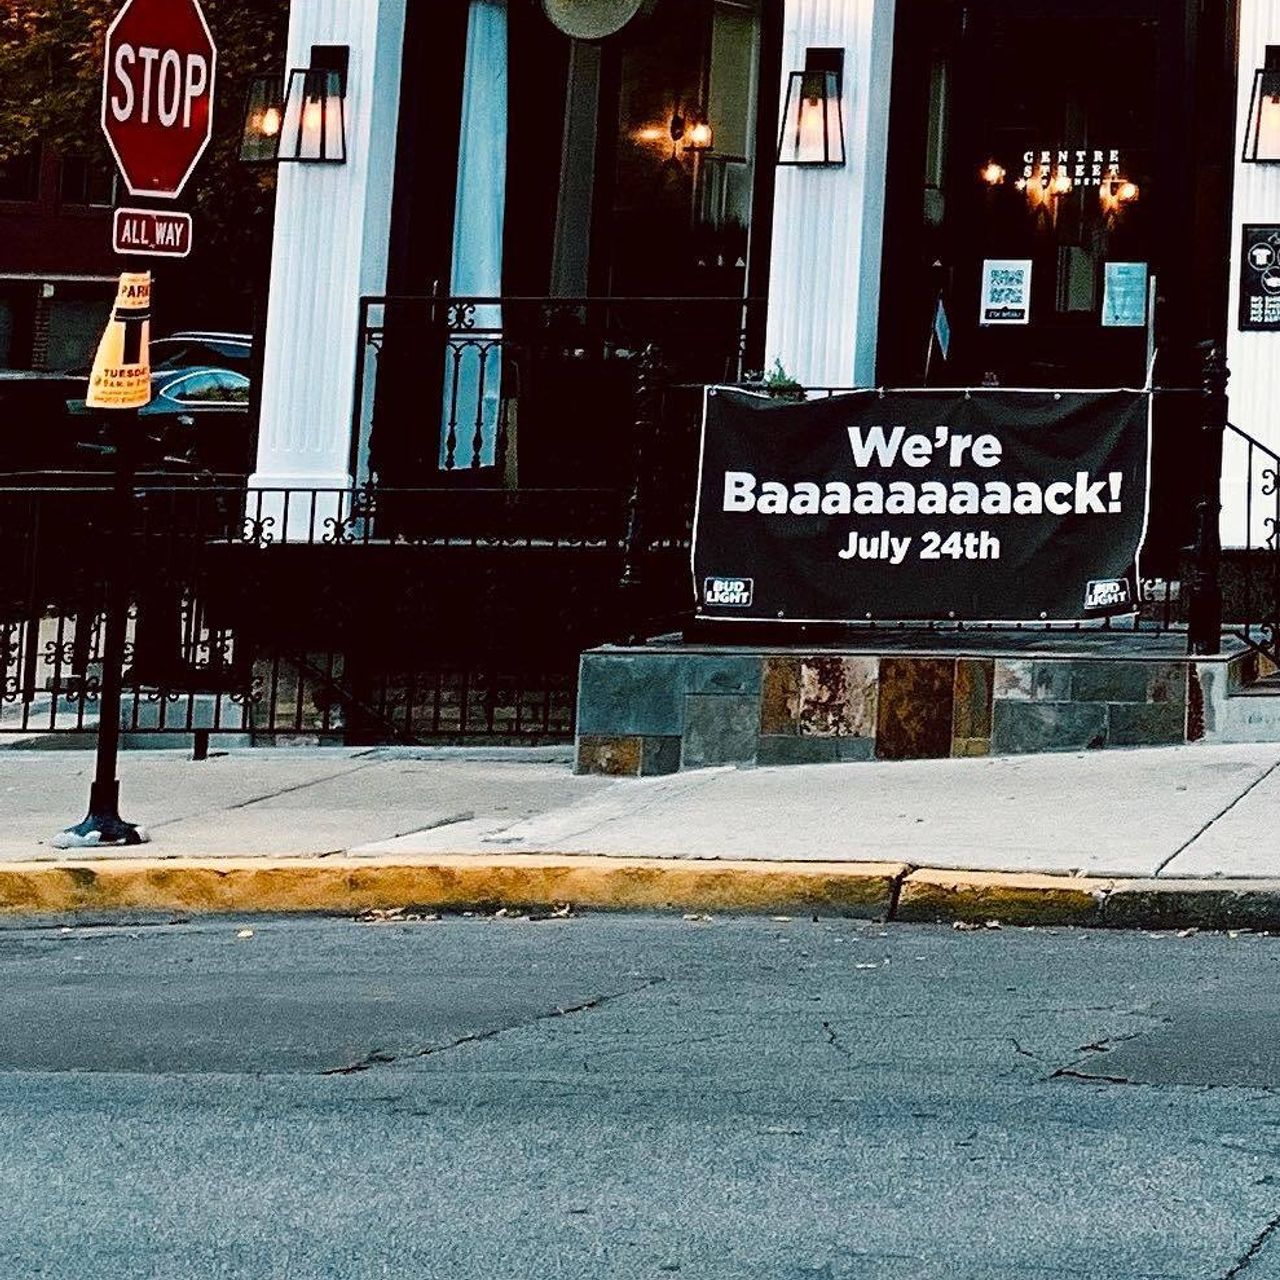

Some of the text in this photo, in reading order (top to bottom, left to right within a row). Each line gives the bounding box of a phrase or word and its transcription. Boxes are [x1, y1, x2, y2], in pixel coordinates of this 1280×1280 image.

[111, 42, 207, 129] STOP
[1023, 149, 1119, 163] CENTRE
[1023, 163, 1120, 179] STREET
[121, 219, 184, 246] ALL WAY
[847, 425, 1003, 469] We're
[722, 470, 1123, 515] Baaaaaaaaack!
[838, 530, 1001, 565] July 24th
[712, 580, 745, 592] BUD
[1093, 582, 1121, 595] BUD
[706, 590, 750, 604] LIGHT
[1087, 590, 1127, 606] LIGHT
